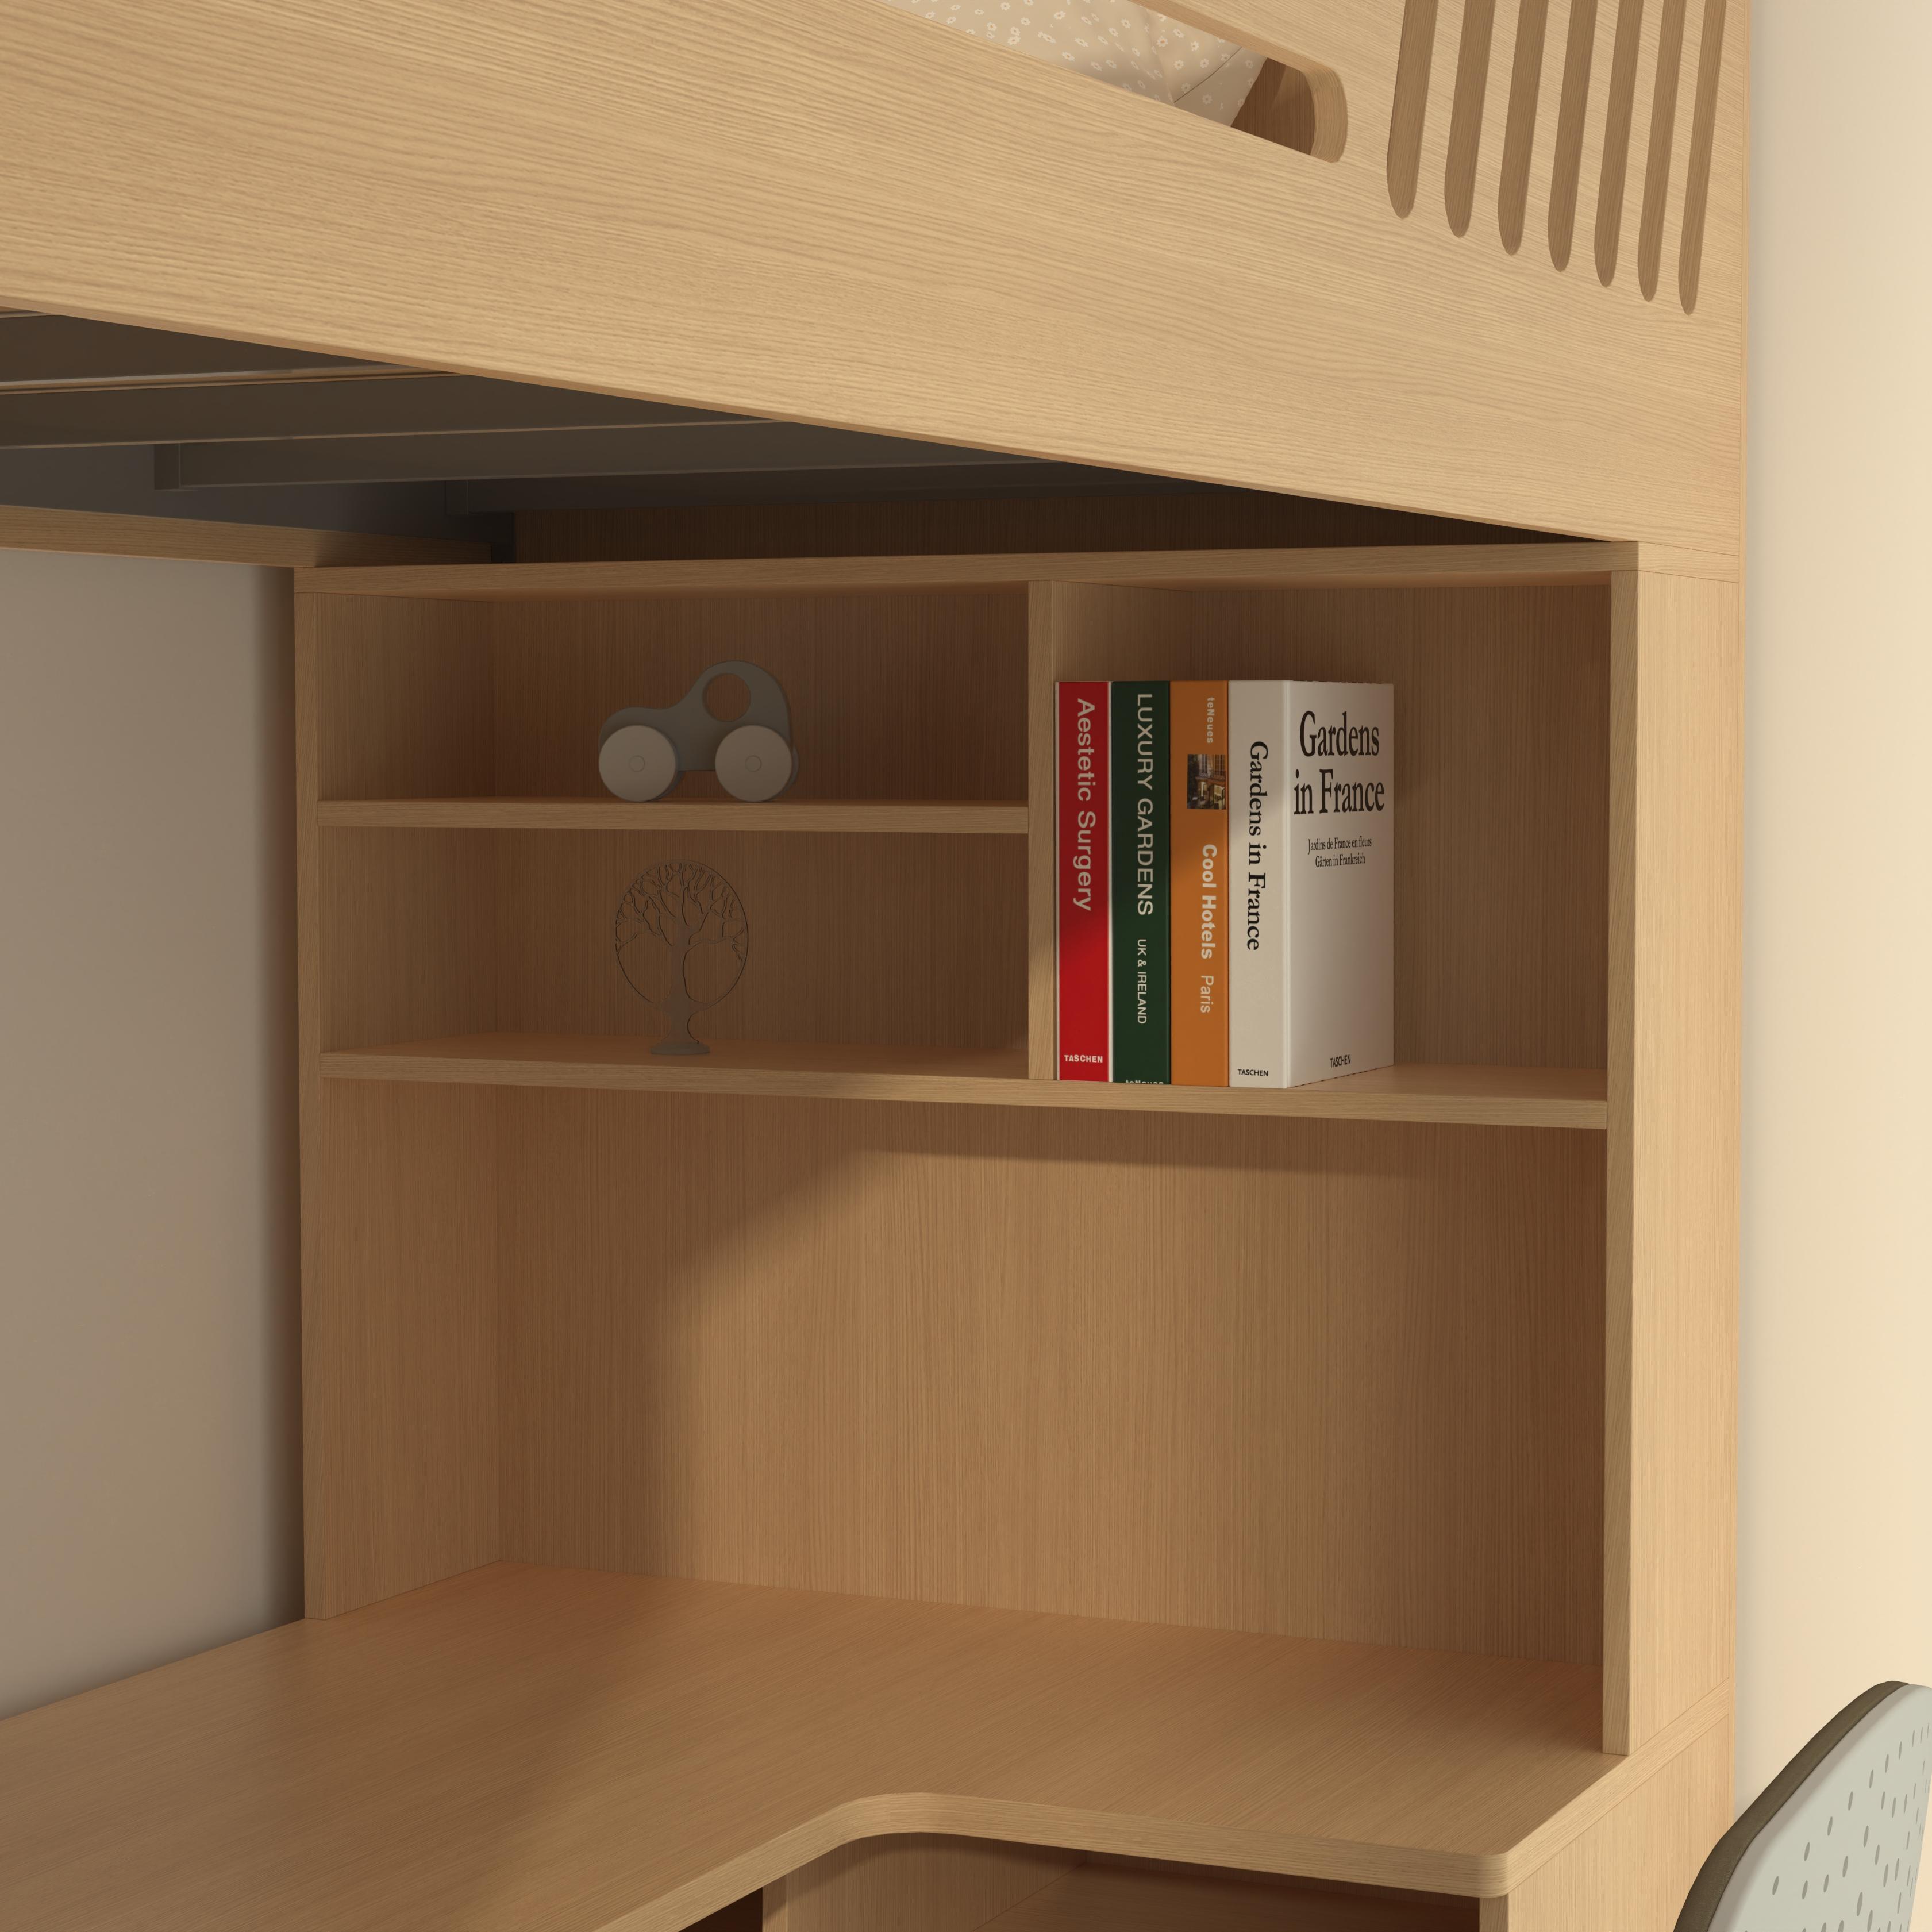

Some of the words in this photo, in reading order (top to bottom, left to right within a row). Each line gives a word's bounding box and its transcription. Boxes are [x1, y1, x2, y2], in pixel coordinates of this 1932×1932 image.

[1137, 694, 1153, 790] LUXURY
[1206, 697, 1215, 744] teNeues
[1299, 710, 1380, 758] Gardens
[1077, 698, 1096, 802] Aestetic
[1249, 741, 1269, 837] Gardens
[1294, 769, 1314, 815] in
[1319, 768, 1385, 814] France
[1073, 810, 1096, 911] Surgery
[1137, 798, 1153, 915] GARDENS
[1202, 844, 1217, 888] Cool
[1248, 842, 1267, 865] in
[1307, 838, 1326, 855] Jardins
[1327, 837, 1333, 850] de
[1334, 837, 1351, 849] France
[1358, 835, 1372, 848] fleurs
[1315, 855, 1333, 868] Gärten
[1333, 854, 1338, 866] in
[1339, 852, 1365, 866] Frankreich
[1201, 895, 1217, 959] Hotels
[1246, 872, 1266, 951] France
[1137, 939, 1146, 956] UK
[1137, 959, 1147, 967] &
[1137, 972, 1147, 1024] IRELAND
[1200, 975, 1214, 1013] Paris
[1064, 1054, 1103, 1063] TASCHEN
[1237, 1068, 1269, 1076] TASCHEN
[1330, 1054, 1351, 1068] TASCHEN
